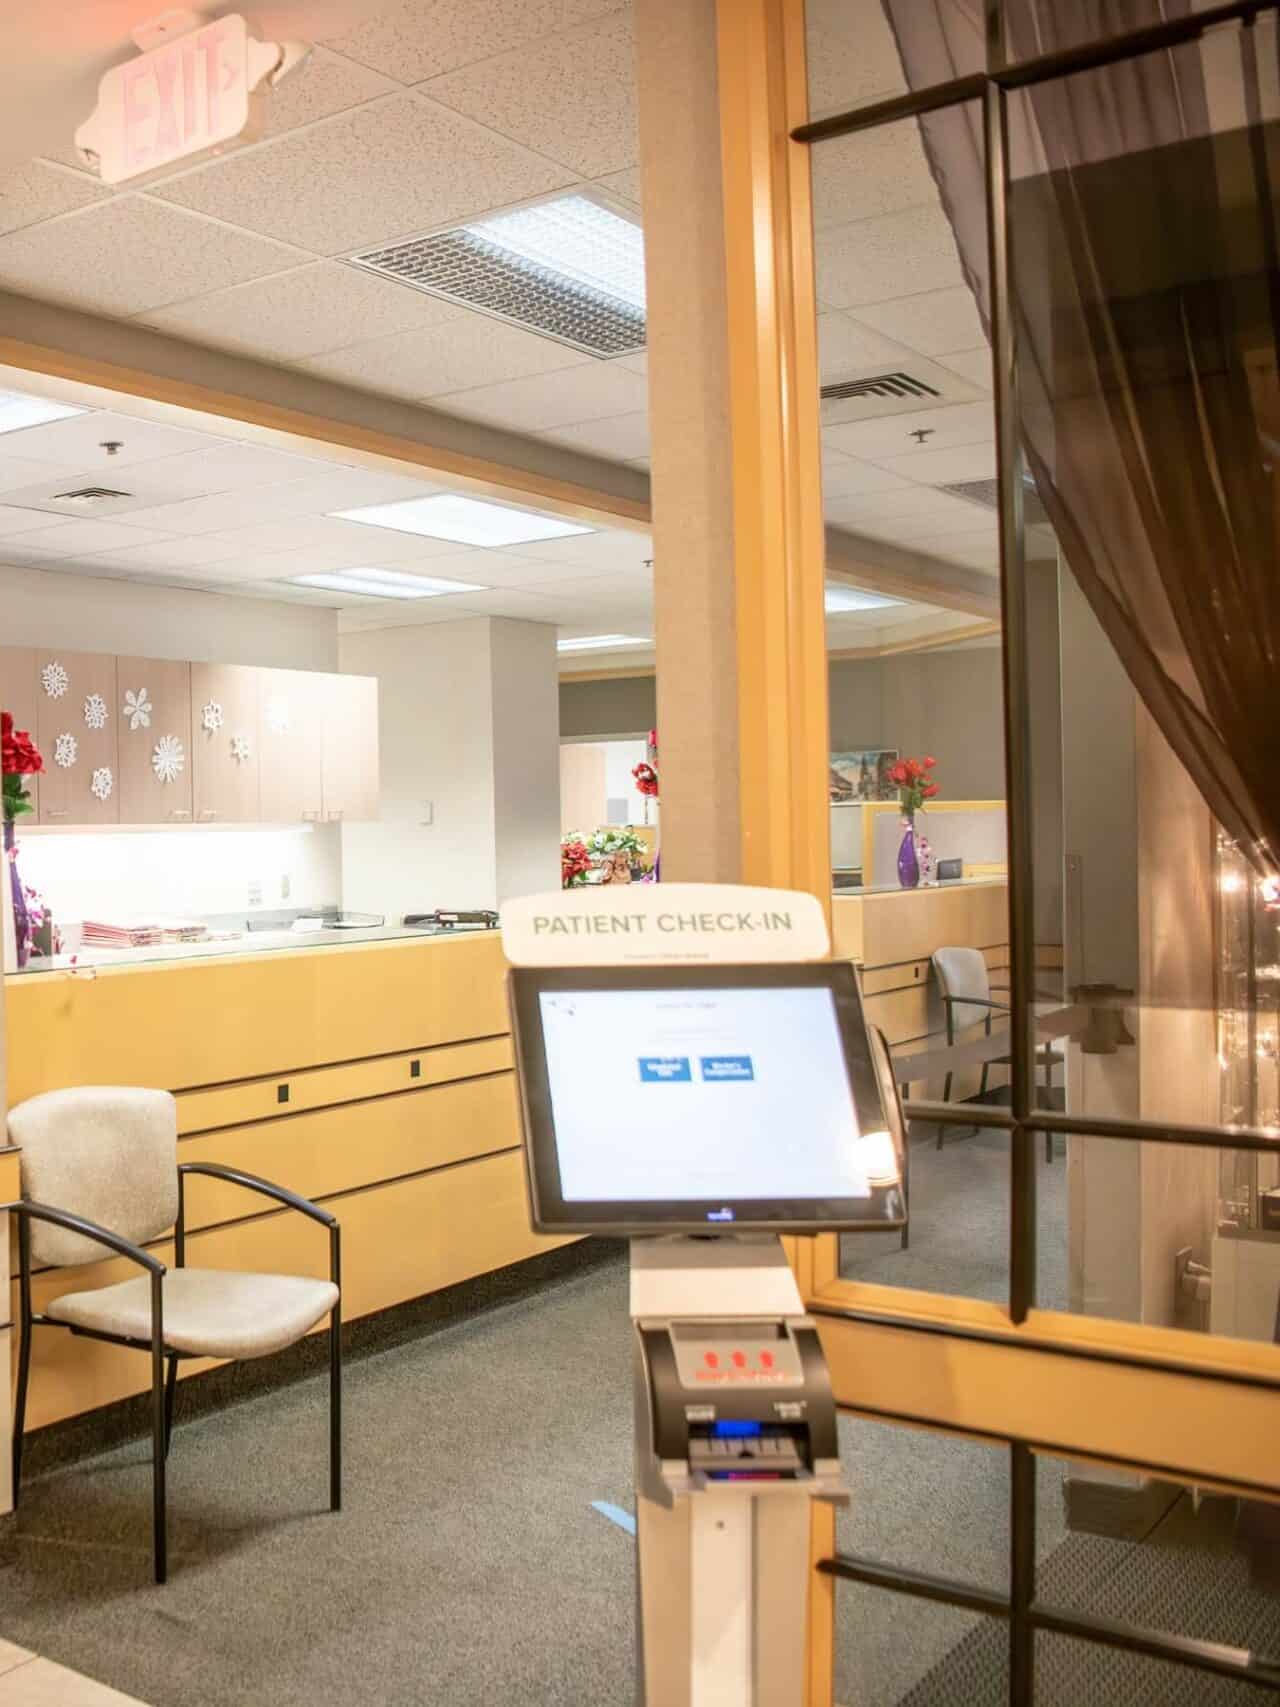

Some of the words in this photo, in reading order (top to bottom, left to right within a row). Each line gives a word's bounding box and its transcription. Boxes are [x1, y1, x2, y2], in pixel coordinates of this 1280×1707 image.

[122, 28, 226, 167] EXIT
[533, 914, 647, 935] PATIENT
[657, 911, 793, 933] CHECK-IN
